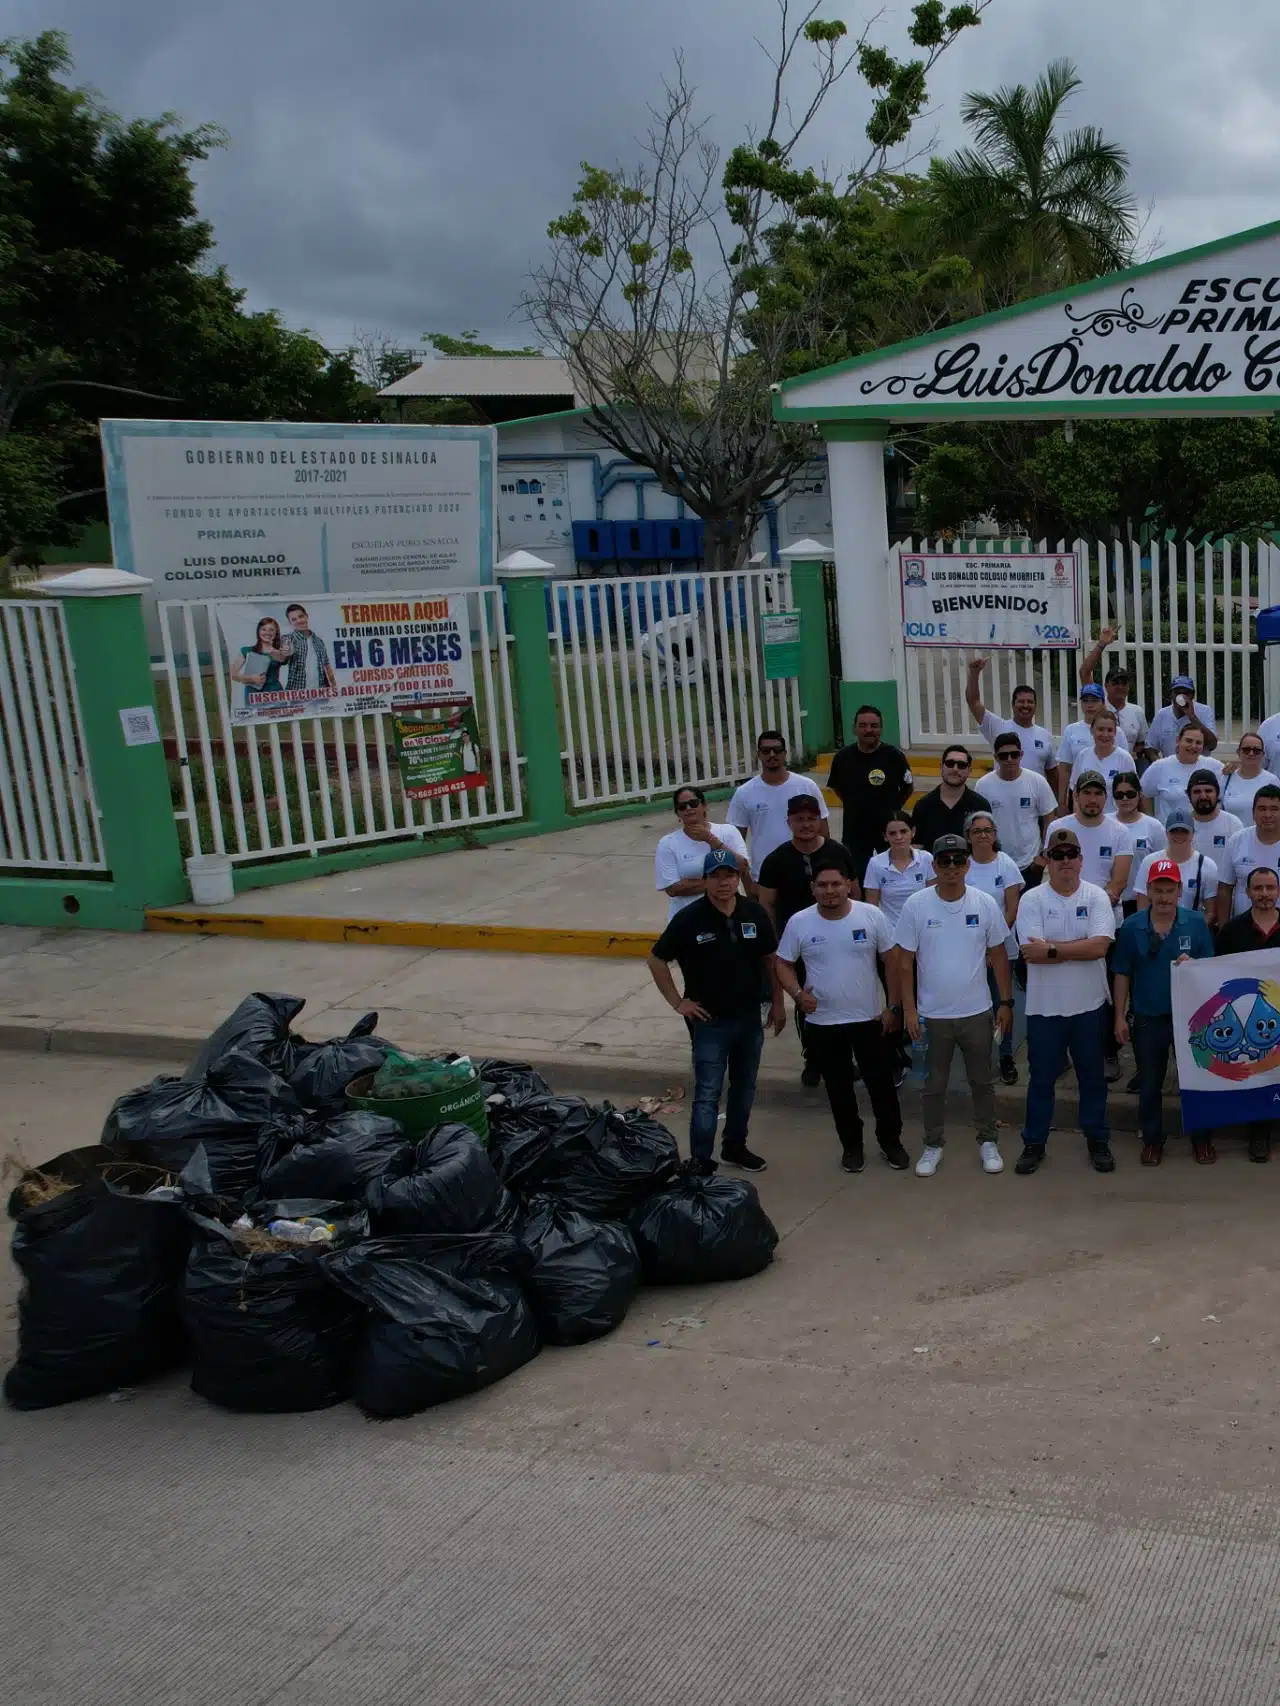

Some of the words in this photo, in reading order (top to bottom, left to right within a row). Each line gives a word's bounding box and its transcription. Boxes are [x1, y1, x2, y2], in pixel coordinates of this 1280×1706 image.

[913, 342, 1028, 398] Luis
[1026, 338, 1231, 396] Donaldo
[186, 450, 264, 464] GOBIERNO
[270, 451, 297, 464] DEL
[302, 451, 355, 464] ESTADO
[361, 452, 376, 464] DE
[382, 452, 437, 465] SINALOA
[294, 470, 347, 483] 2017-2021
[166, 508, 202, 519] FONDO
[210, 508, 221, 518] DE
[228, 506, 307, 518] APORTACIONES
[197, 529, 266, 540] PRIMARIA
[184, 557, 216, 567] LUIS
[220, 554, 286, 566] DONALDO
[165, 570, 227, 581] COLOSIO
[232, 566, 301, 578] MURRIETA
[932, 572, 946, 581] LUIS
[948, 572, 979, 581] DONALDO
[980, 572, 1007, 581] COLOSIO
[341, 603, 411, 624] TERMINA
[414, 598, 449, 621] AQUÍ
[932, 595, 1048, 615] BIENVENIDOS
[336, 628, 347, 638] TU
[350, 626, 395, 637] PRIMARIA
[396, 625, 402, 635] O
[334, 640, 364, 669] EN
[368, 638, 385, 667] 6
[390, 633, 462, 665] MESES
[353, 668, 395, 683] CURSOS
[396, 663, 450, 679] GRATUITOS
[248, 688, 338, 705] INSCRIPCIONES
[342, 684, 391, 697] ABIERTAS
[394, 680, 419, 692] TODO
[434, 676, 454, 689] AÑO
